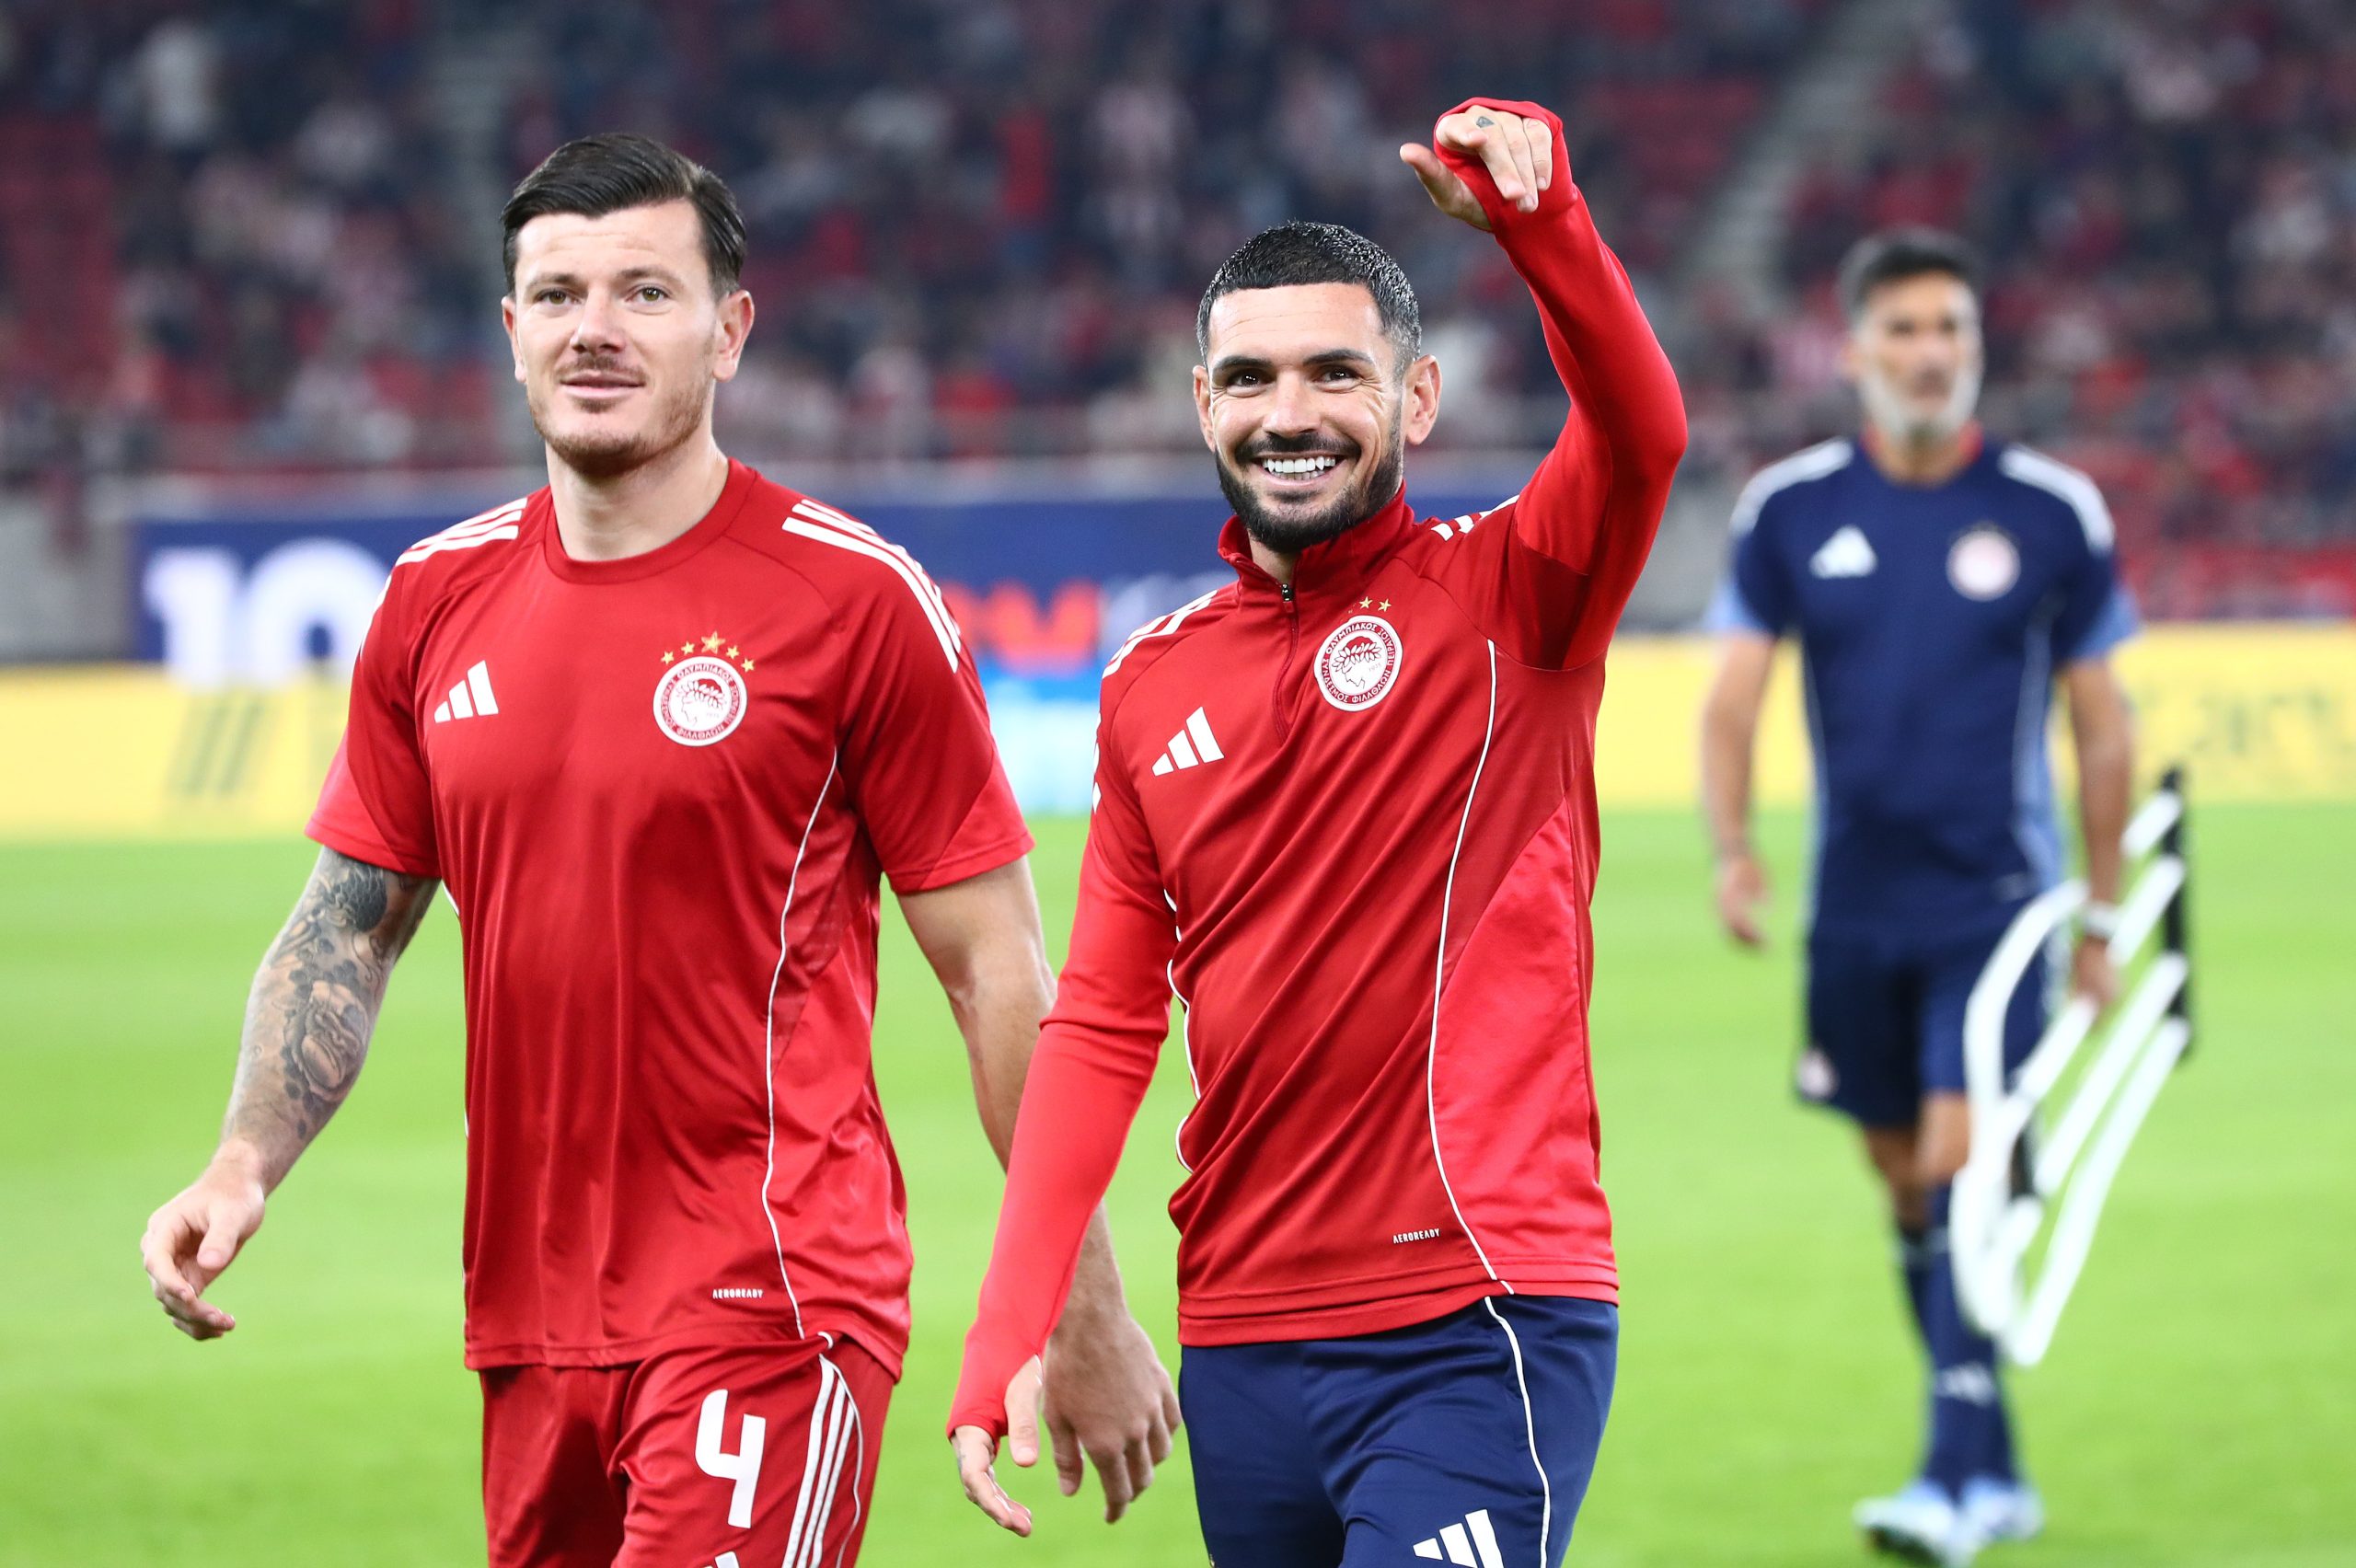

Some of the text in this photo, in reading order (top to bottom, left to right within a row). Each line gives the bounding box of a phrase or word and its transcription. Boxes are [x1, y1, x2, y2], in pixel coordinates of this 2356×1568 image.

[1326, 622, 1378, 654] ΟΛΥΜΠΙΑΚΟΣ
[1392, 1228, 1440, 1244] AEROREADY
[712, 1288, 763, 1299] AEROREADY
[695, 1389, 767, 1529] 4
